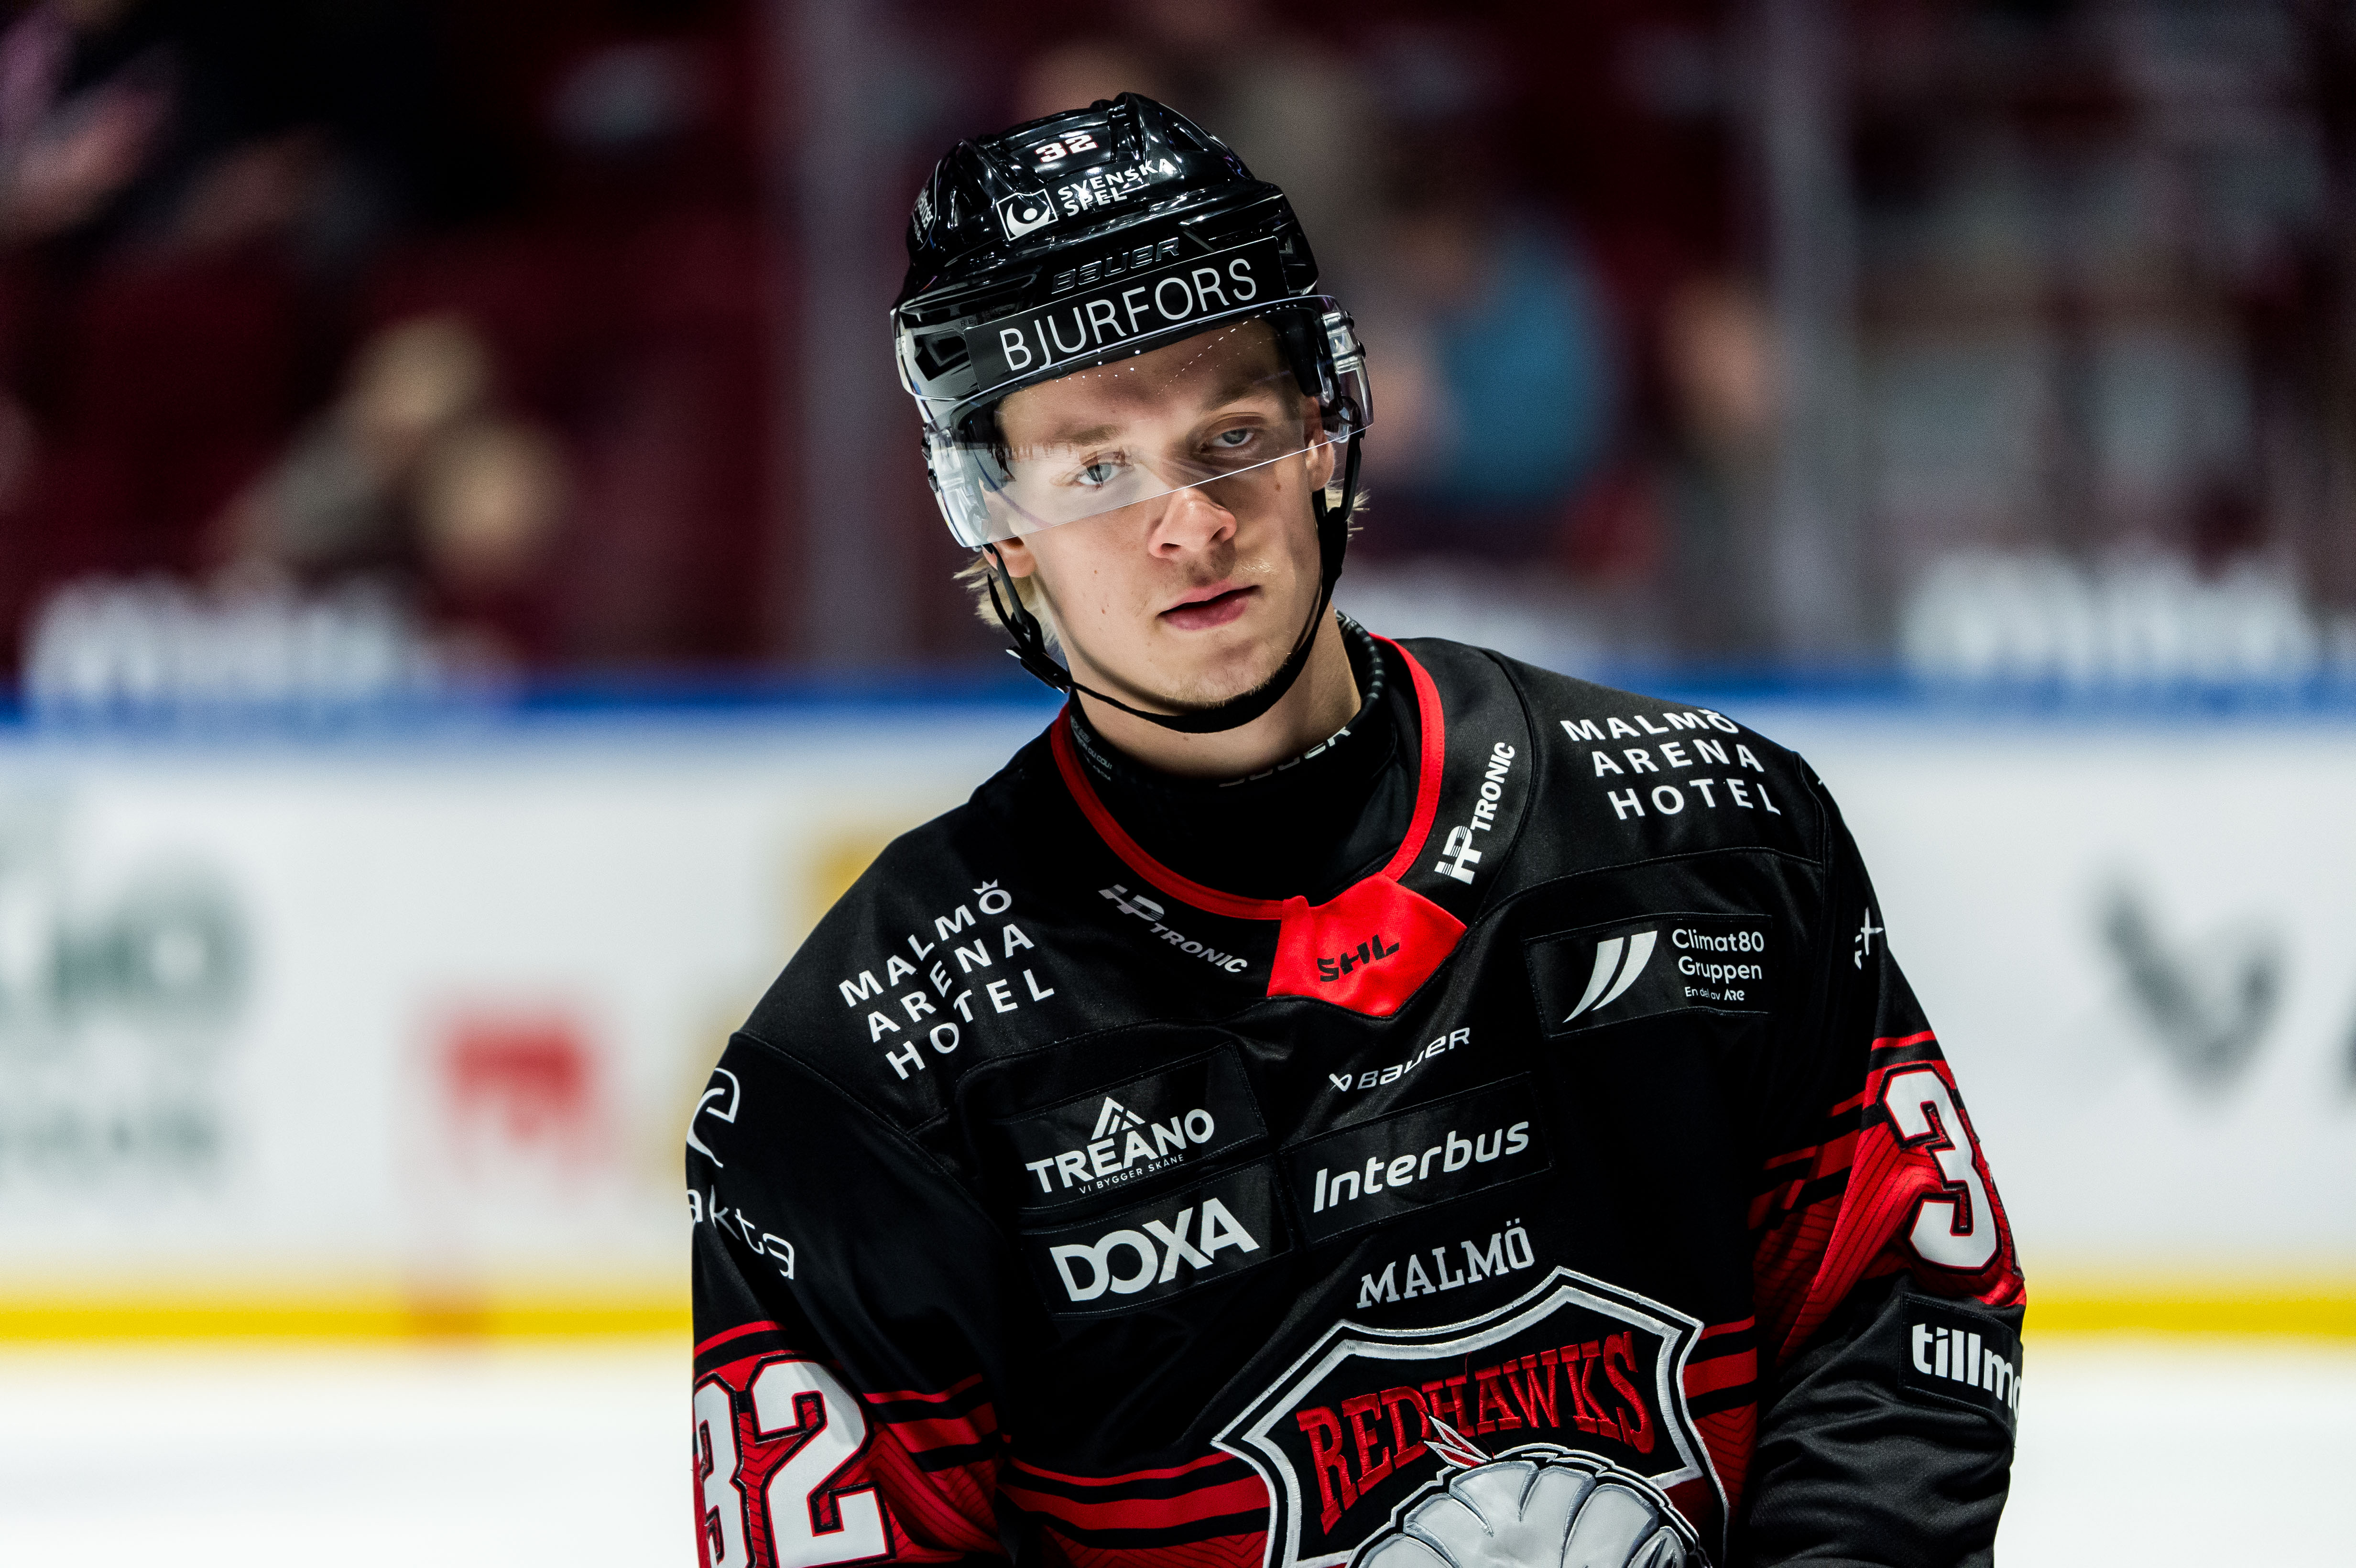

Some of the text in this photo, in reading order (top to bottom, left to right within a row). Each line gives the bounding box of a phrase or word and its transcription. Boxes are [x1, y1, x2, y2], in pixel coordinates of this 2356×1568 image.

[1034, 135, 1098, 163] 32
[1058, 158, 1177, 201] SVENSKA
[1064, 187, 1127, 217] SPEL
[1000, 259, 1256, 370] BJURFORS
[1560, 709, 1739, 741] MALMÖ
[1592, 739, 1764, 777] ARENA
[1607, 779, 1781, 820] HOTEL
[839, 878, 1012, 1006] MALMÖ
[1317, 934, 1399, 982] SHL
[1672, 929, 1764, 952] Climat80
[1679, 956, 1762, 984] Gruppen
[867, 924, 1034, 1042] ARENA
[1685, 986, 1698, 997] En
[1700, 988, 1710, 998] del
[1711, 991, 1721, 1000] av
[885, 969, 1054, 1080] HOTEL
[1025, 1109, 1214, 1193] TREANO
[1079, 1154, 1185, 1194] VI BYGGER SKÅNE
[1314, 1122, 1529, 1212] Interbus
[1880, 1066, 2008, 1273] 3
[1049, 1198, 1260, 1301] DOXA
[1356, 1218, 1535, 1309] MALMÖ
[693, 1359, 892, 1568] 32
[1297, 1331, 1655, 1535] REDHAWKS
